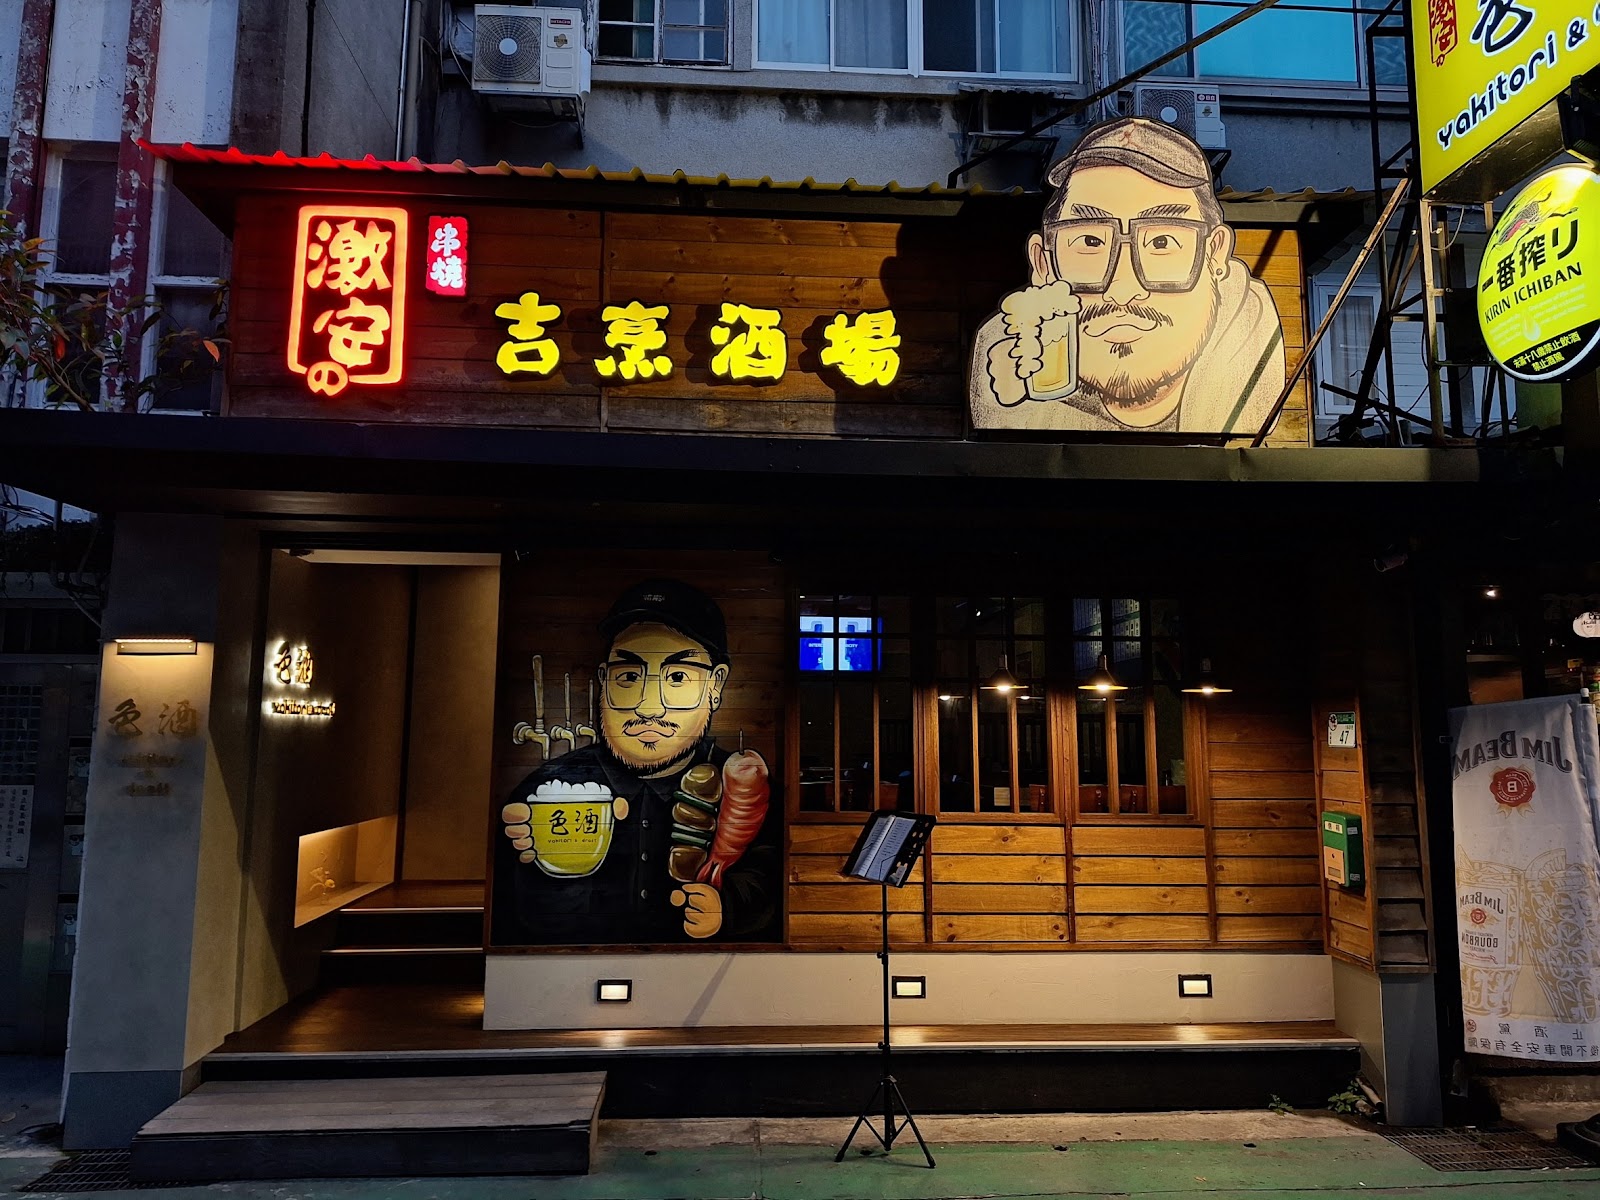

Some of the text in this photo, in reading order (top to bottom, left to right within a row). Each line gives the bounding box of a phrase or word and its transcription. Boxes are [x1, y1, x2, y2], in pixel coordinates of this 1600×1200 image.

[1568, 20, 1586, 48] &
[1482, 219, 1578, 293] 一番搾り
[1485, 296, 1511, 324] KIRIN
[1514, 262, 1582, 305] ICHIBAN
[1339, 730, 1350, 745] 47
[549, 808, 599, 835] 色酒
